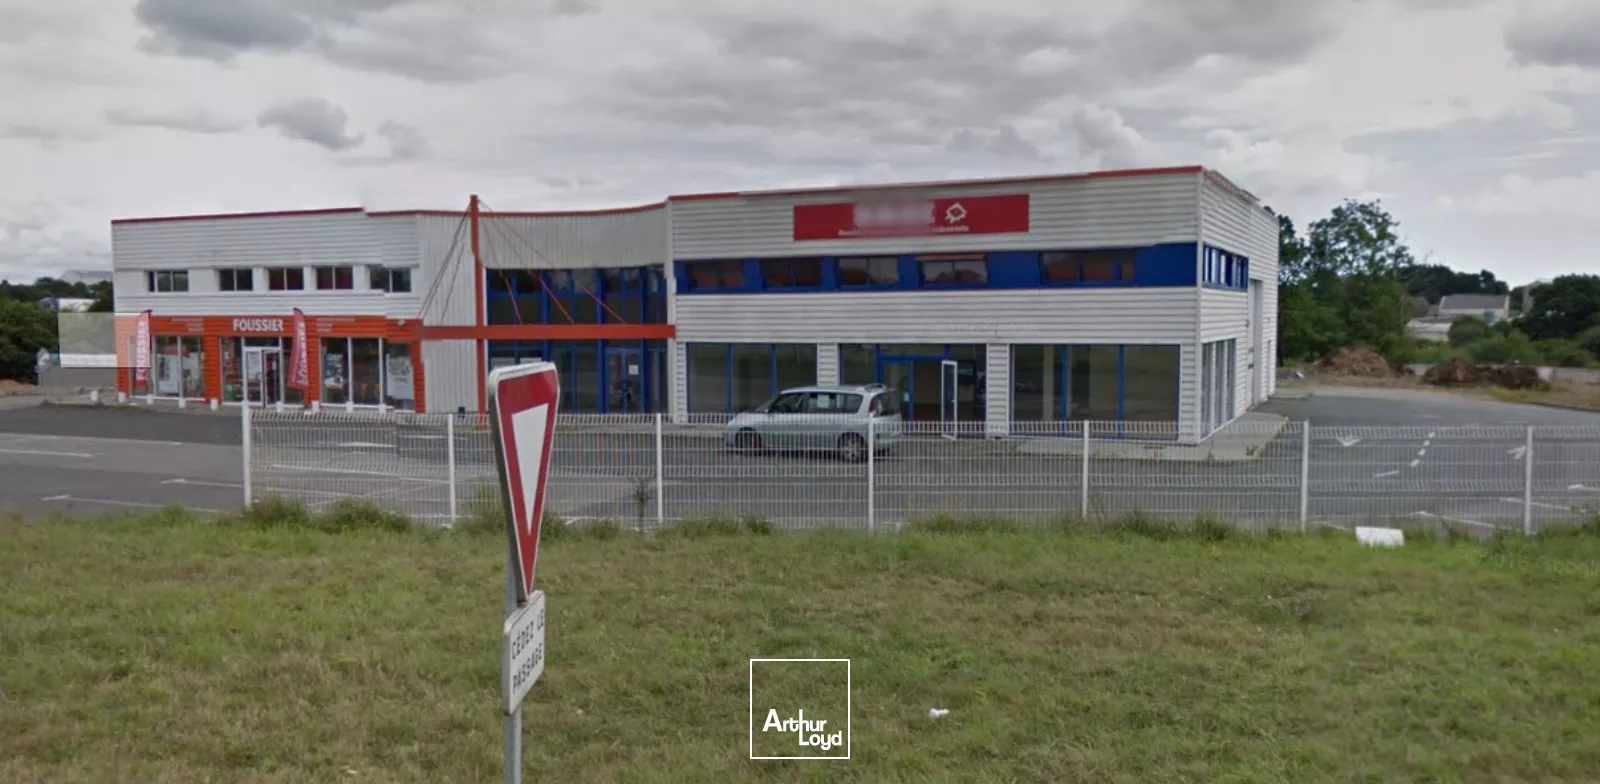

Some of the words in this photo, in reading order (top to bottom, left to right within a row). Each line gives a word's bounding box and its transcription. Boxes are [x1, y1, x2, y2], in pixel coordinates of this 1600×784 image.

[232, 318, 285, 332] FOUSSIER
[537, 608, 544, 631] LE
[512, 643, 542, 694] PASSAGE
